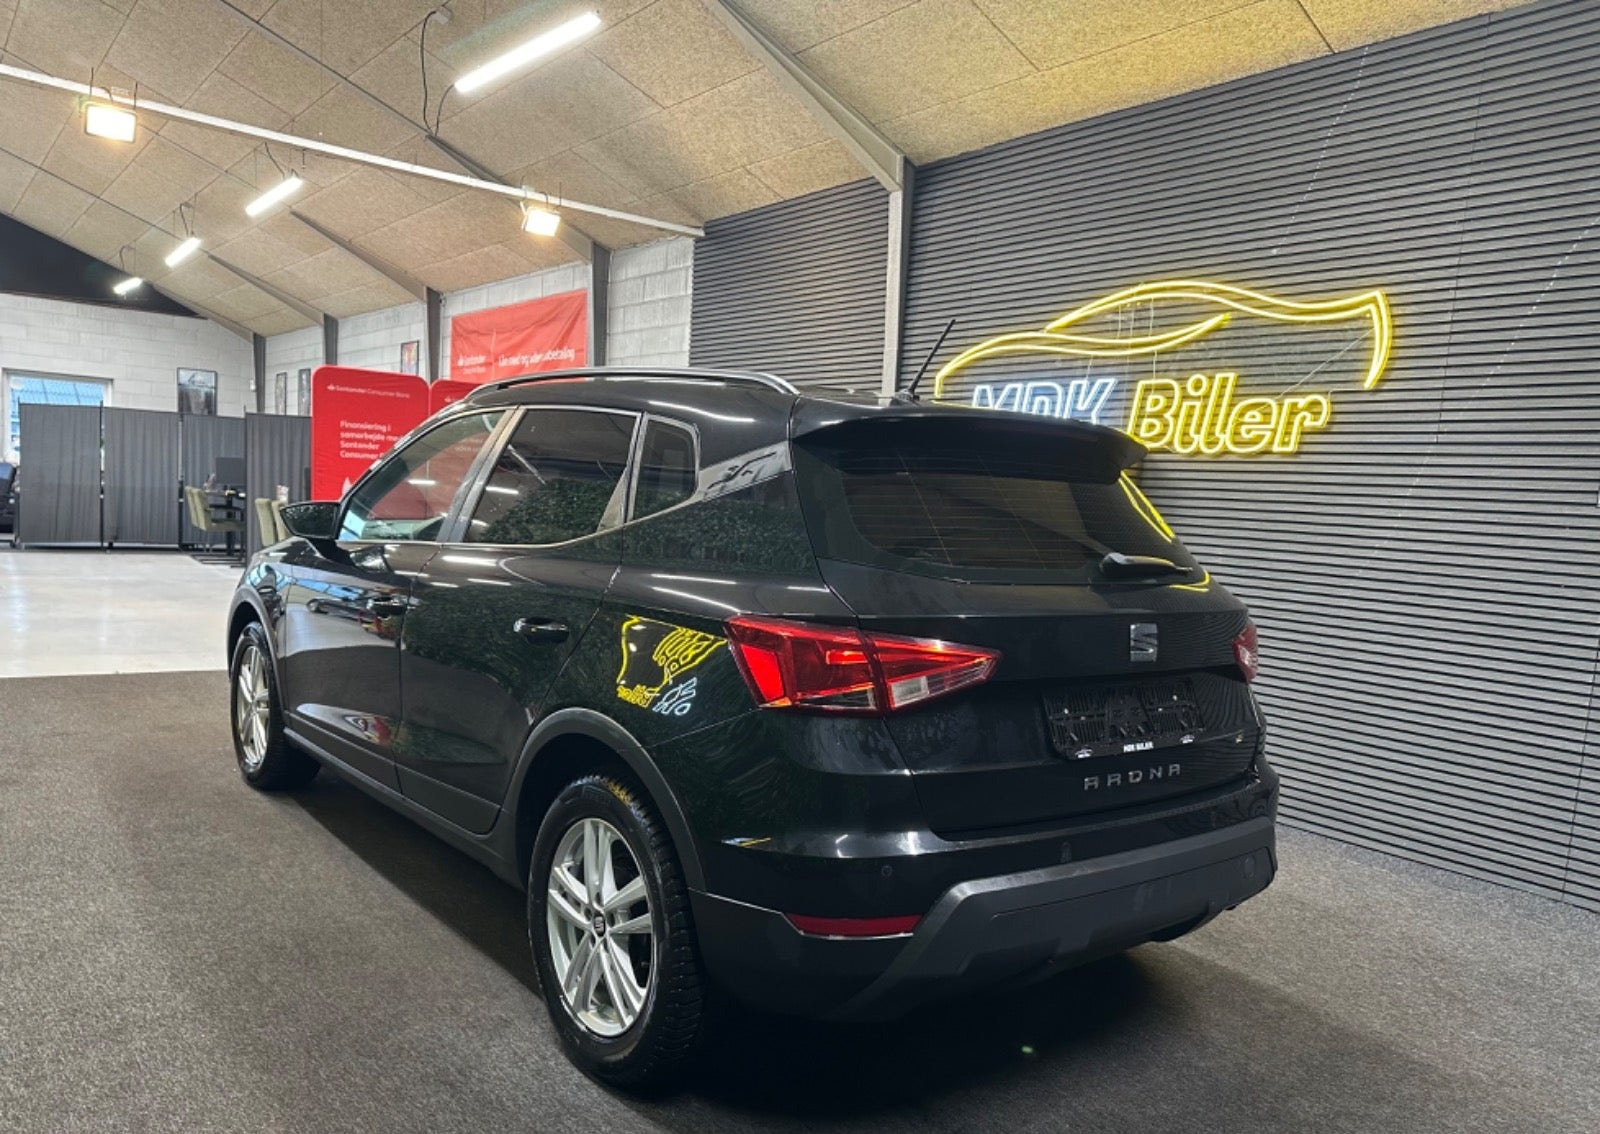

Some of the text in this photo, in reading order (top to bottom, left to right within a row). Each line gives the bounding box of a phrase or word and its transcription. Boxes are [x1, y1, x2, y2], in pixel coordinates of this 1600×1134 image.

[1127, 372, 1331, 455] Biler
[340, 420, 386, 432] Finansiering
[340, 432, 385, 441] samarbejde
[340, 440, 380, 450] Santander
[339, 450, 378, 459] Consumer
[1083, 763, 1182, 791] ARONA
